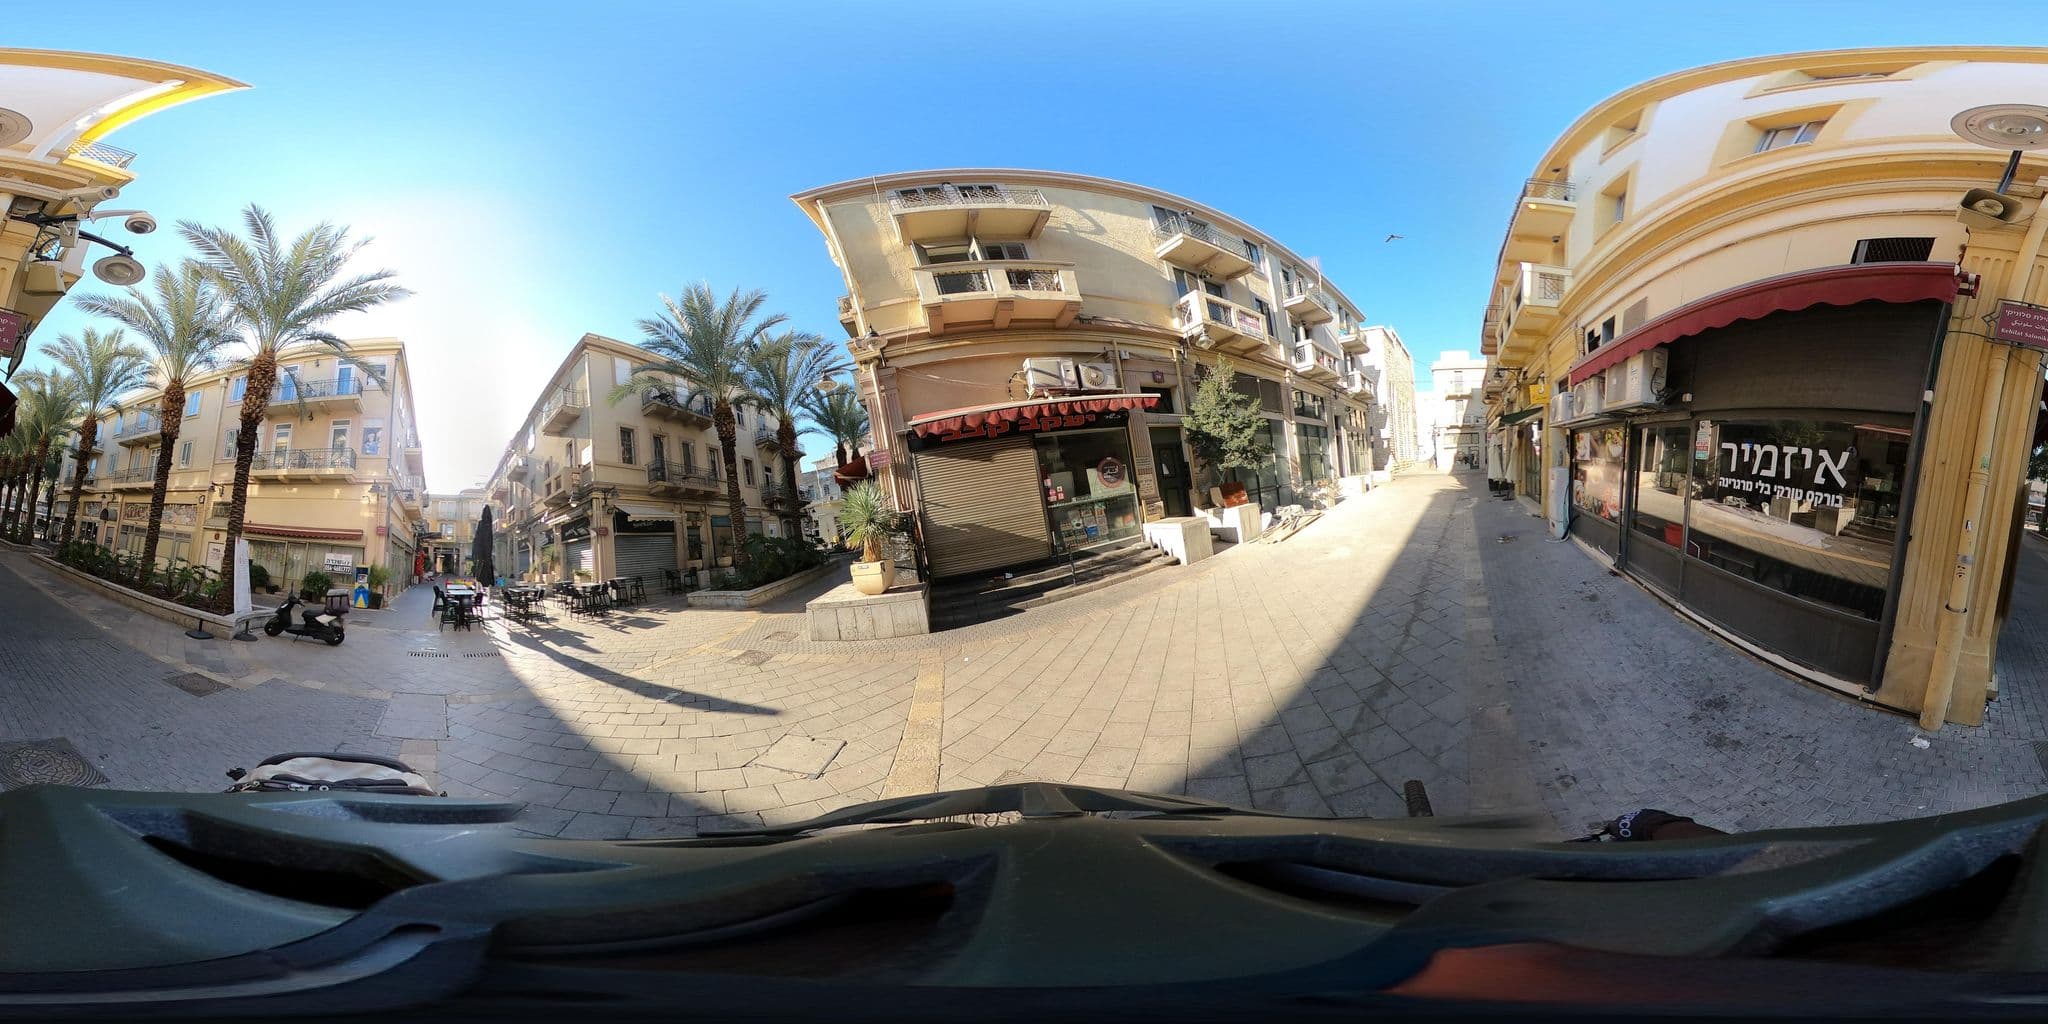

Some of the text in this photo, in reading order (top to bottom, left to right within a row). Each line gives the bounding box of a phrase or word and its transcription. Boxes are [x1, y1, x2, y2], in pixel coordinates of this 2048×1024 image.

[1721, 442, 1850, 488] איזמיר
[1719, 476, 1843, 508] בורקס טורקי בלי מרגרינה
